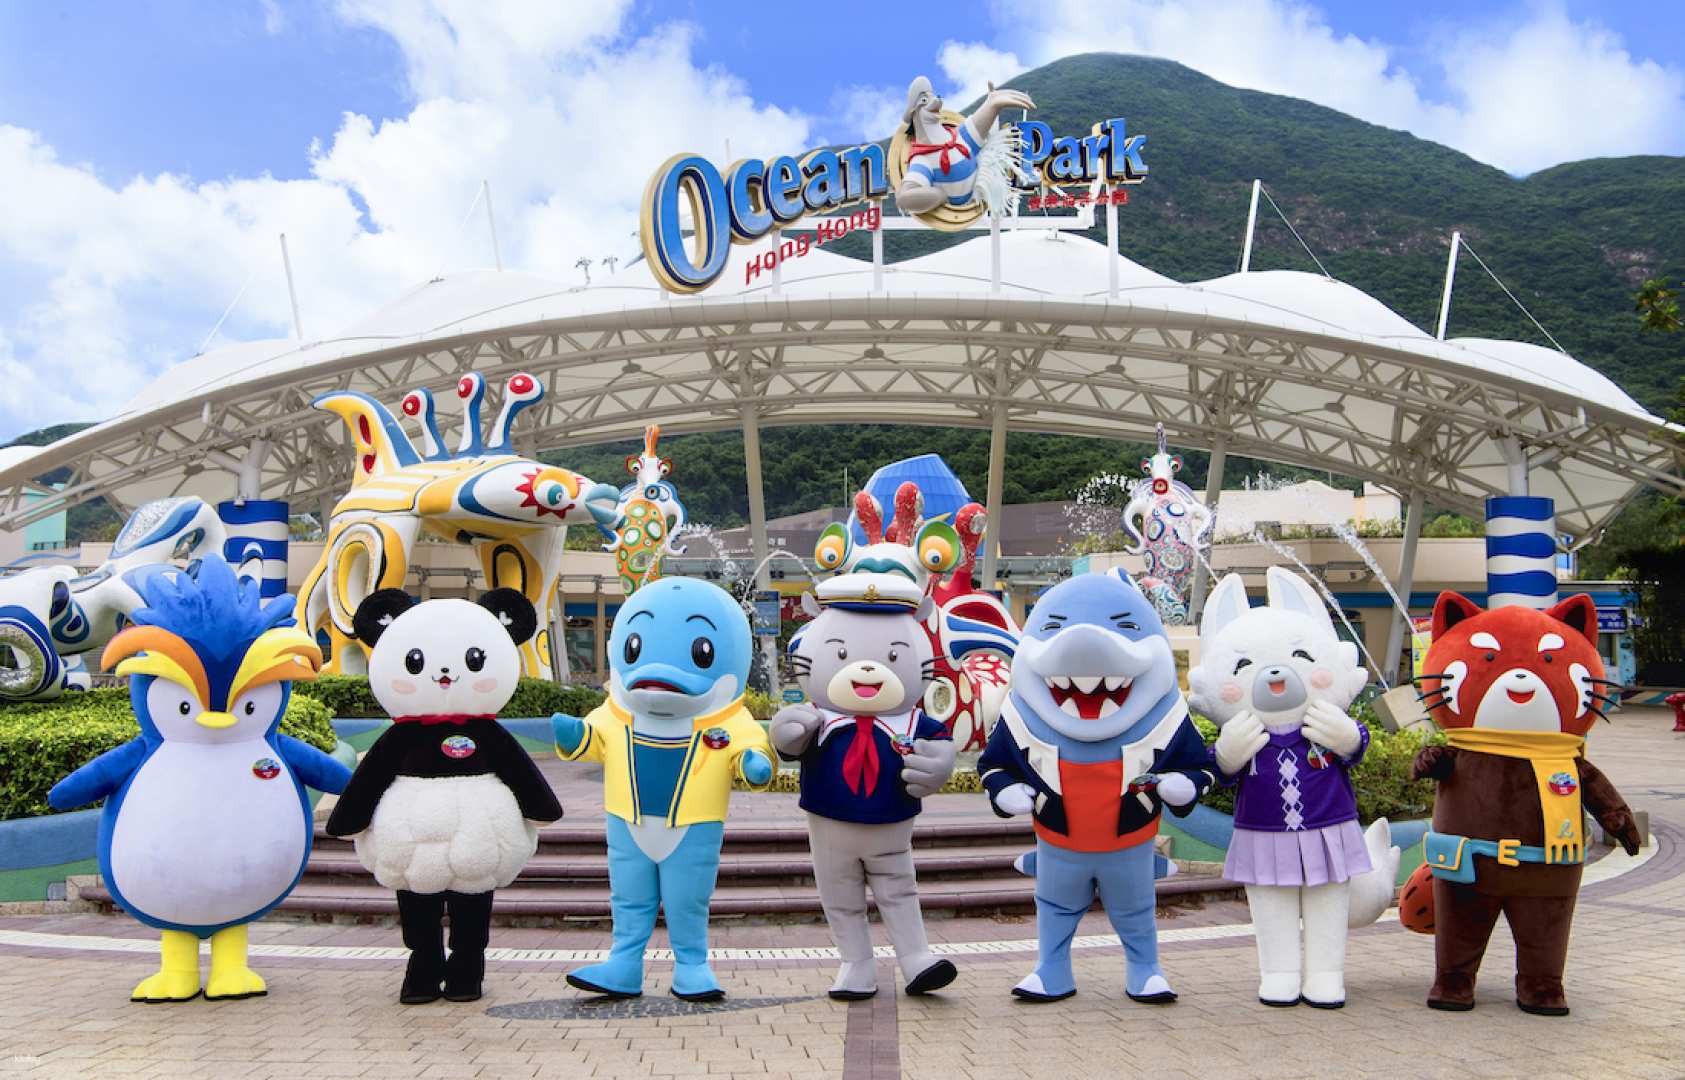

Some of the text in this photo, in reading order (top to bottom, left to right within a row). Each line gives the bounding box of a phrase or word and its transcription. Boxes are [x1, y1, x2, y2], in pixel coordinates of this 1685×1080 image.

[641, 118, 1149, 294] Ocean Park
[745, 207, 881, 286] Hong Kong
